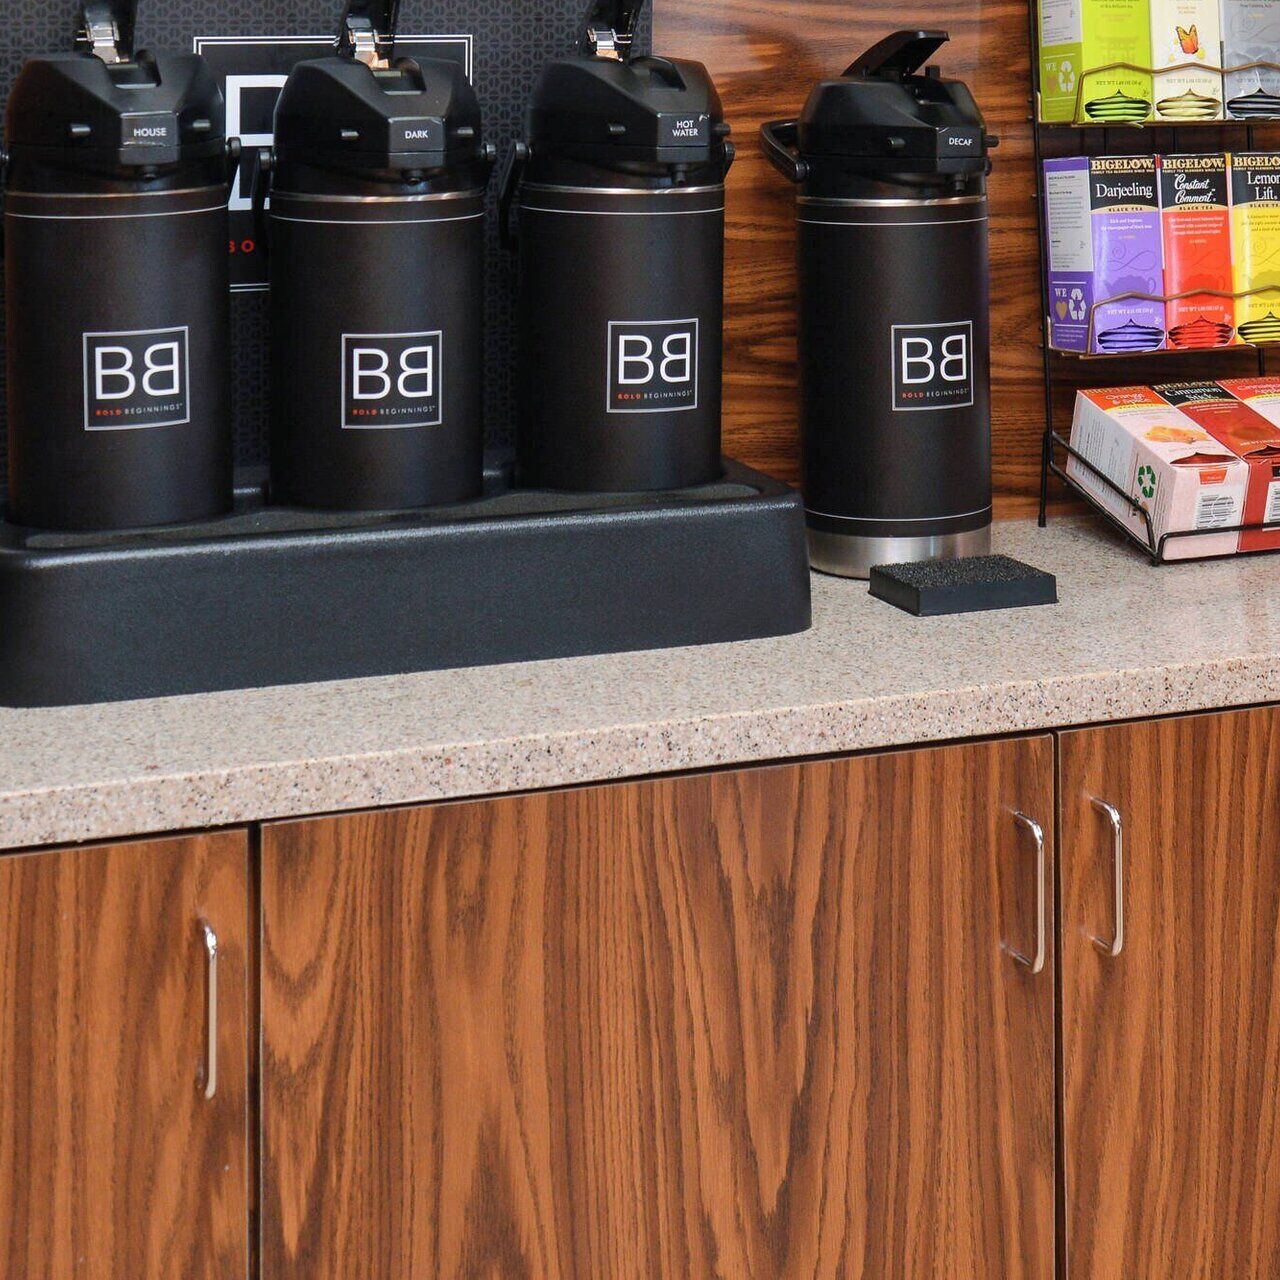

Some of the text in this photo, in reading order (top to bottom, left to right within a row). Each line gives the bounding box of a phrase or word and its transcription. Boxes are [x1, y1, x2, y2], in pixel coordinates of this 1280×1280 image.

[676, 120, 694, 128] HOT
[133, 127, 167, 137] HOUSE
[404, 130, 429, 139] DARK
[672, 128, 698, 136] WATER
[948, 137, 973, 146] DECAF
[1091, 159, 1154, 170] BIGELOW
[1162, 158, 1225, 169] BIGELOW
[1096, 182, 1153, 200] Darjeeling
[1255, 186, 1274, 200] Lift
[1055, 288, 1067, 297] WE
